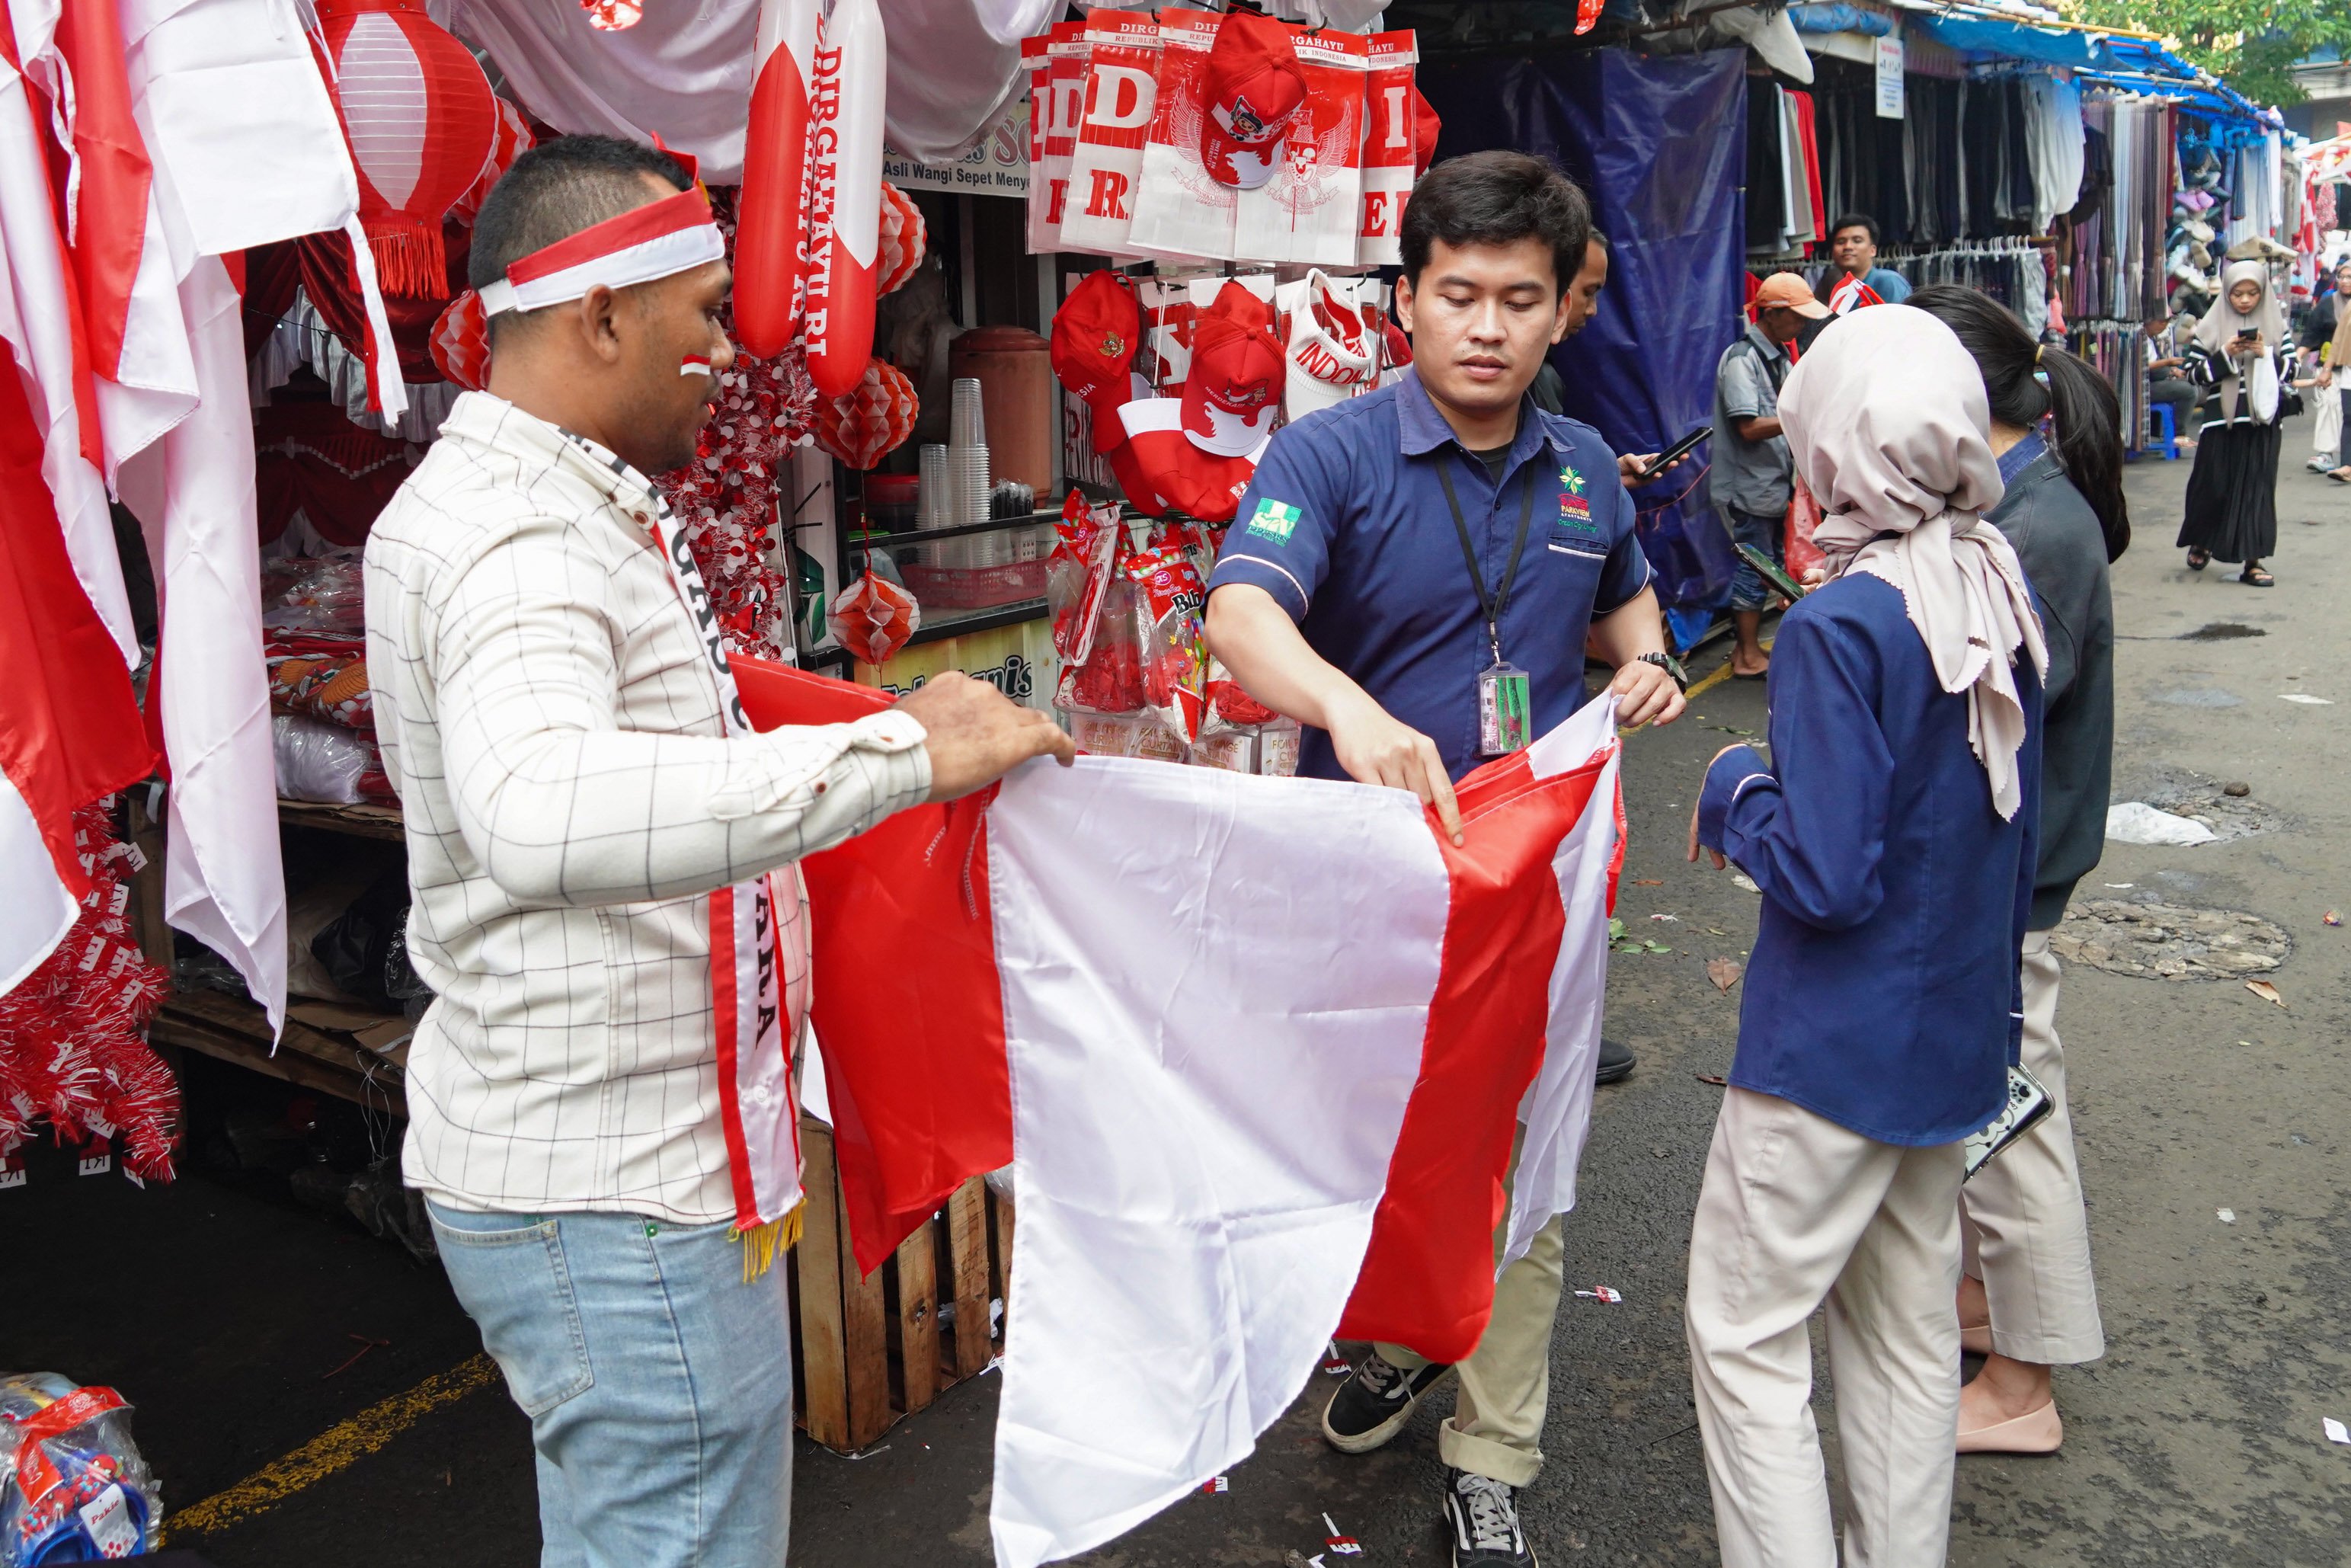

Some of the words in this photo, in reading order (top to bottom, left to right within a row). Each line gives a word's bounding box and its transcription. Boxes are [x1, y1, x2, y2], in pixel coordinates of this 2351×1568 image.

[1115, 35, 1158, 44] REPUBLIK
[1312, 50, 1346, 62] INDONESIA
[807, 46, 842, 297] DIRGAHAYU
[883, 162, 908, 177] Asli
[913, 164, 952, 184] Wangi
[957, 168, 992, 186] Sepet
[805, 308, 827, 357] RI
